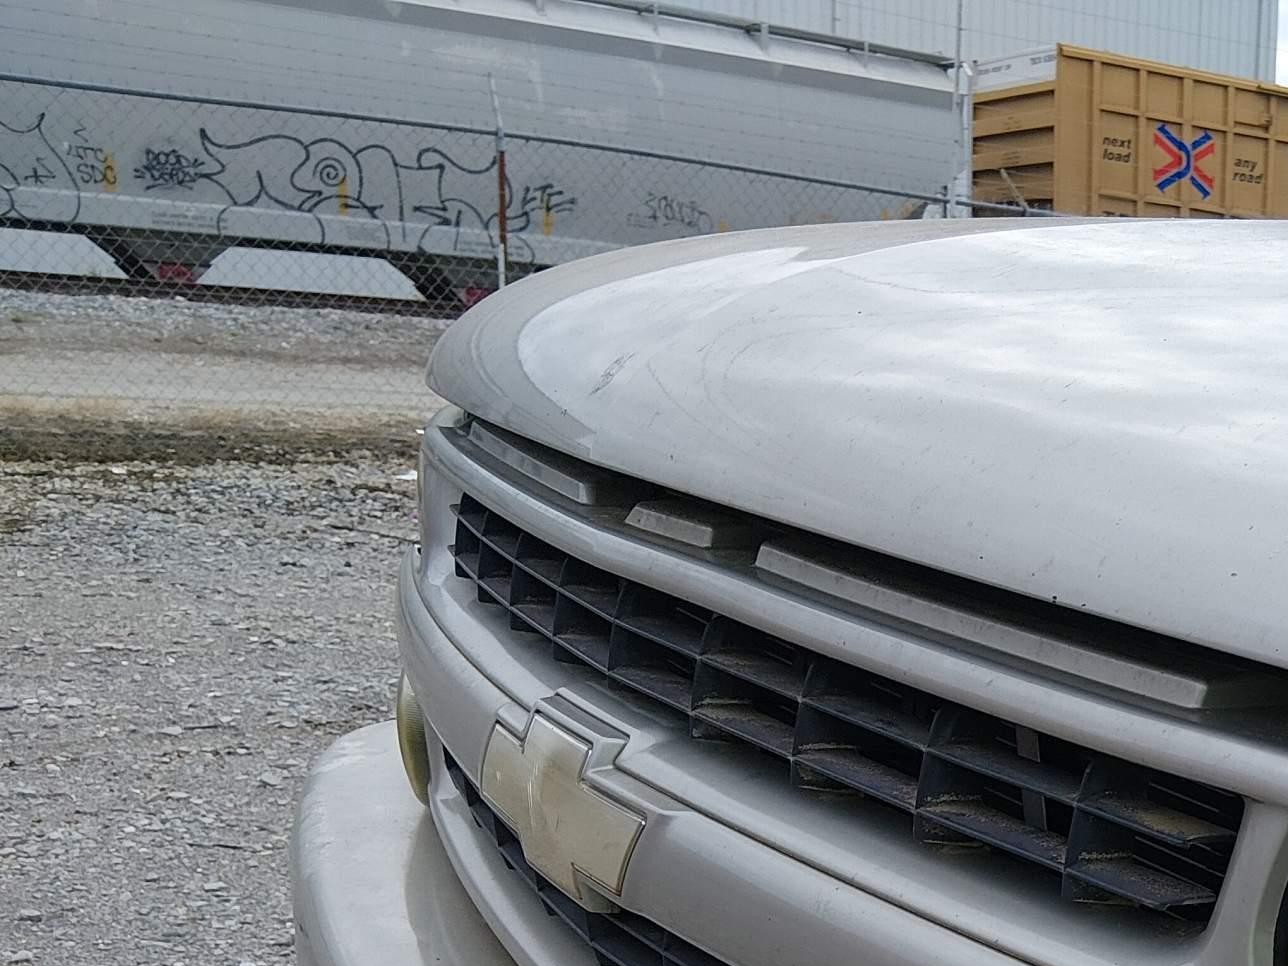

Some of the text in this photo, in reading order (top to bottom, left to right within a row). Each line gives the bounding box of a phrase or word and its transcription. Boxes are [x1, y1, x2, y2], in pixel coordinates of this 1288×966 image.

[1102, 135, 1132, 149] next
[1102, 147, 1131, 163] load
[1233, 157, 1258, 172] any
[1232, 171, 1264, 185] road
